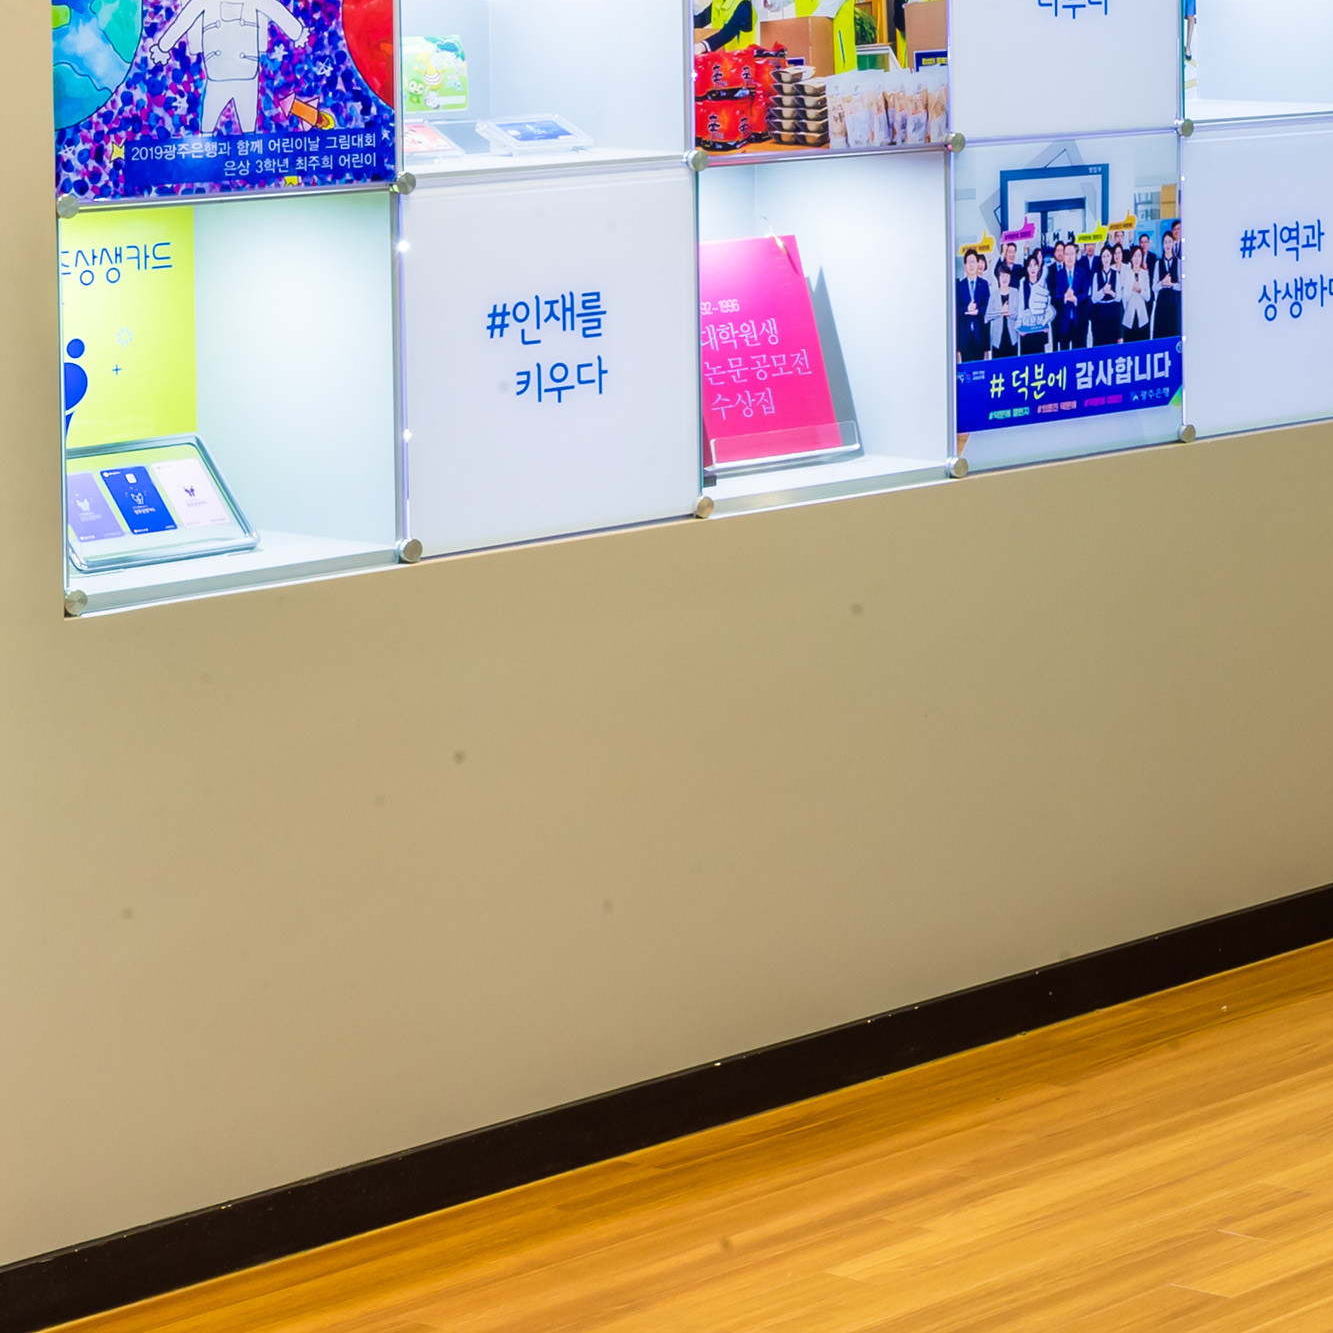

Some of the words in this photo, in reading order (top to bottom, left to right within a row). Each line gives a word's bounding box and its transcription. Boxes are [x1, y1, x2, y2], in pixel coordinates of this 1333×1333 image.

[131, 141, 231, 161] 2019광주은행과
[237, 139, 263, 156] 함께
[269, 137, 320, 153] 어린이날
[326, 133, 376, 150] 그림대회
[224, 159, 250, 176] 은상
[256, 157, 289, 174] 3학년
[296, 155, 333, 172] 최주희
[339, 153, 376, 168] 어린이
[1239, 220, 1325, 262] #지역과
[486, 291, 607, 346] #인재를
[700, 318, 779, 351] 대학원생
[515, 355, 608, 403] 키우다
[704, 348, 812, 386] 논문공모전
[1012, 364, 1067, 401] 덕분에
[1075, 351, 1172, 391] 감사합니다
[712, 387, 776, 421] 수상집
